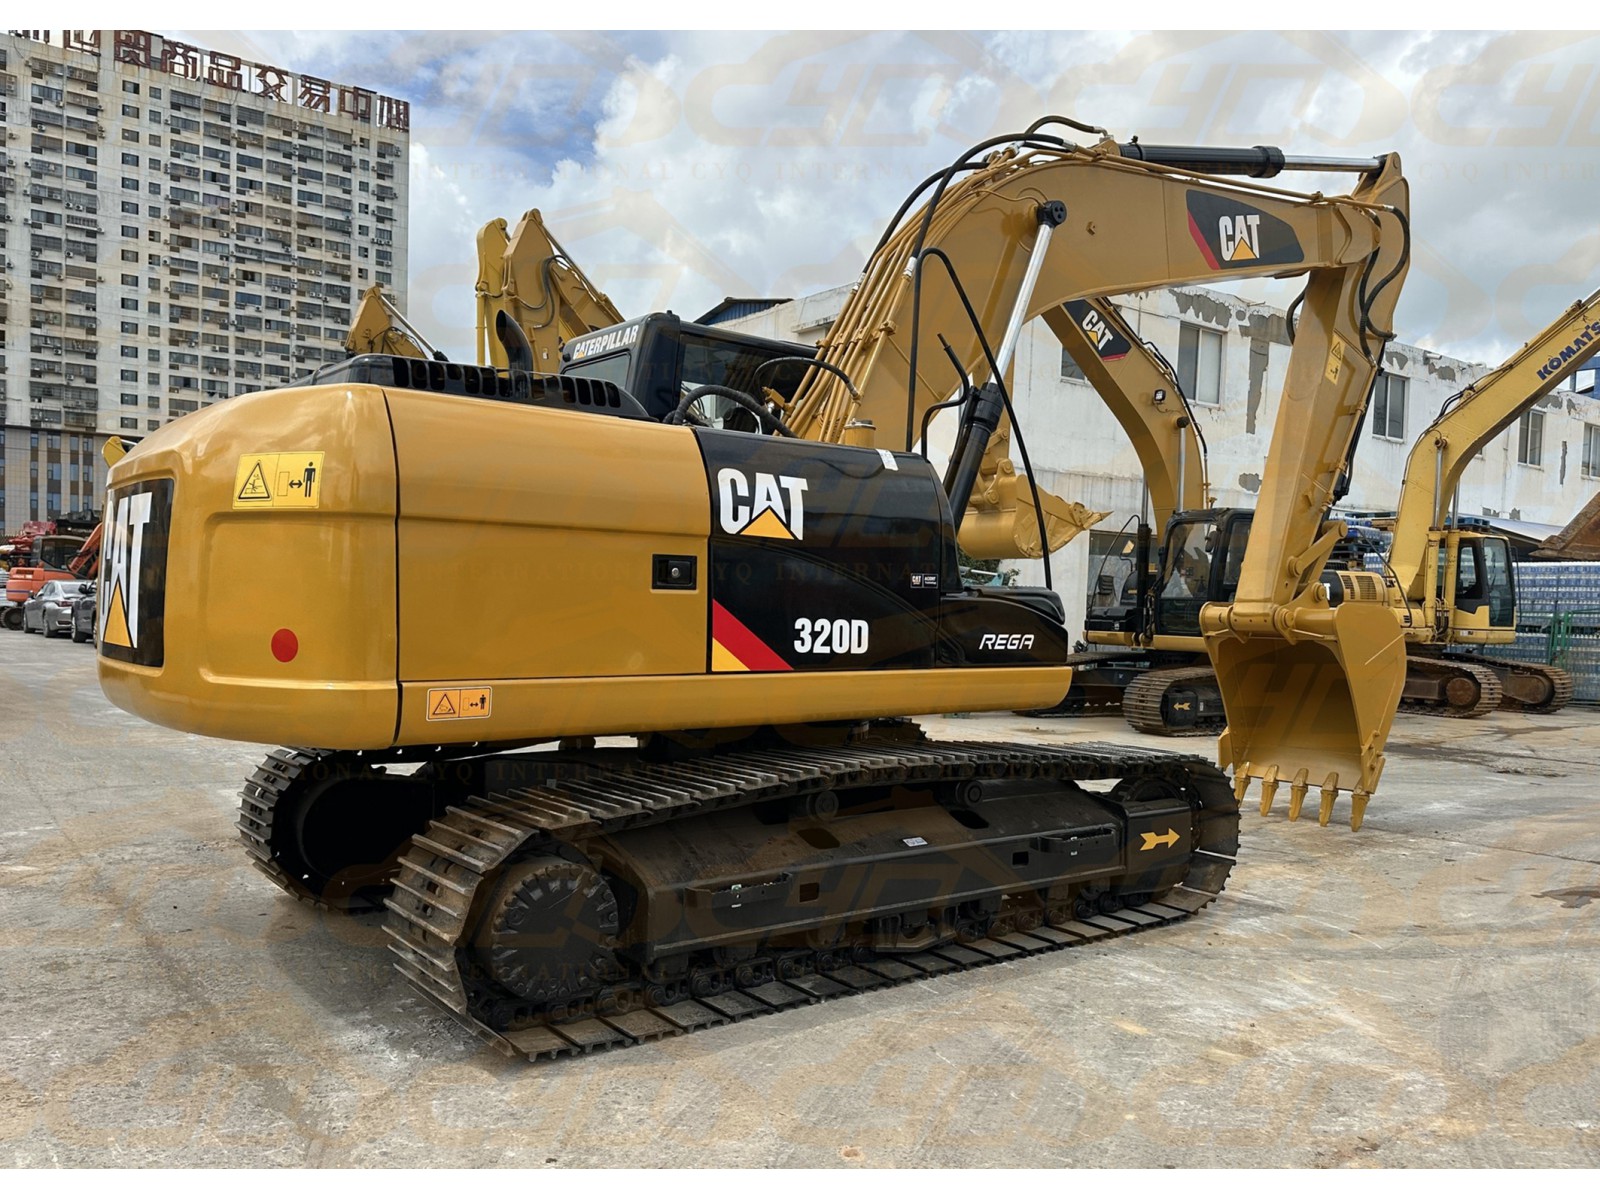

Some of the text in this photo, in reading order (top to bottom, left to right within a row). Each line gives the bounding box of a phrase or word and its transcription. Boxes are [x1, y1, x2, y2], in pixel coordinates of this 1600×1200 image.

[1218, 214, 1261, 262] CAT
[573, 324, 640, 361] CATERPILLAR
[1082, 310, 1114, 351] CAT
[716, 467, 809, 541] CAT
[100, 491, 153, 649] CAT
[793, 617, 870, 655] 320D
[978, 633, 1036, 650] REGA
